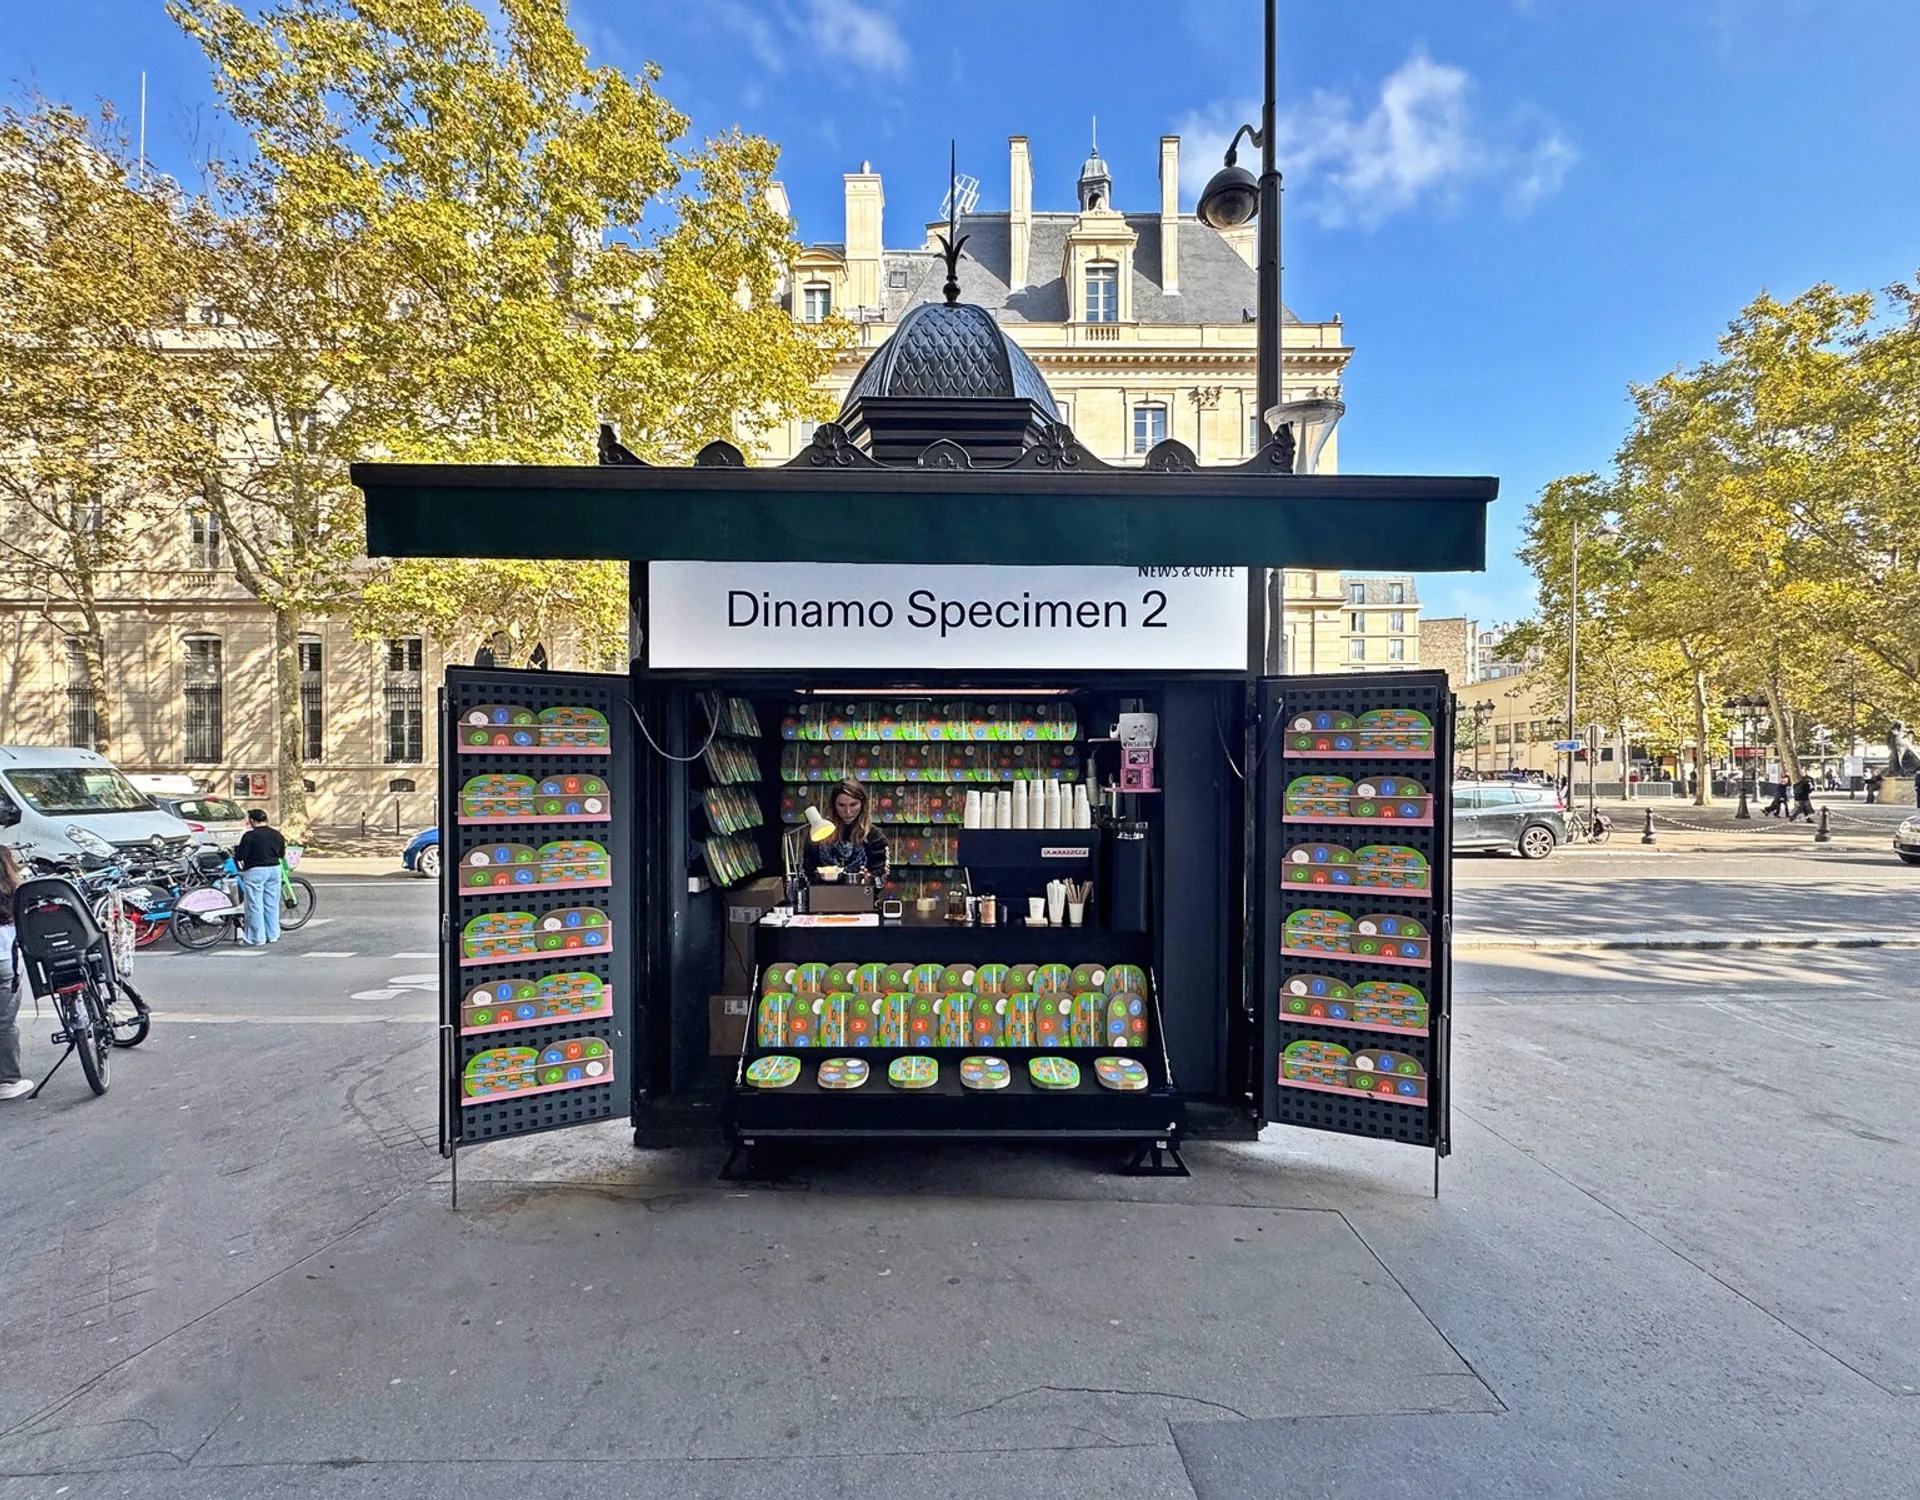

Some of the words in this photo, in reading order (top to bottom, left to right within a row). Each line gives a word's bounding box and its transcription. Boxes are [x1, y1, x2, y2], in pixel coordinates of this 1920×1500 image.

[1138, 566, 1178, 577] NEWS
[1182, 566, 1192, 577] &
[1194, 566, 1235, 577] COFFEE
[729, 590, 894, 628] Dinamo
[908, 589, 1127, 638] Specimen
[1143, 590, 1168, 628] 2
